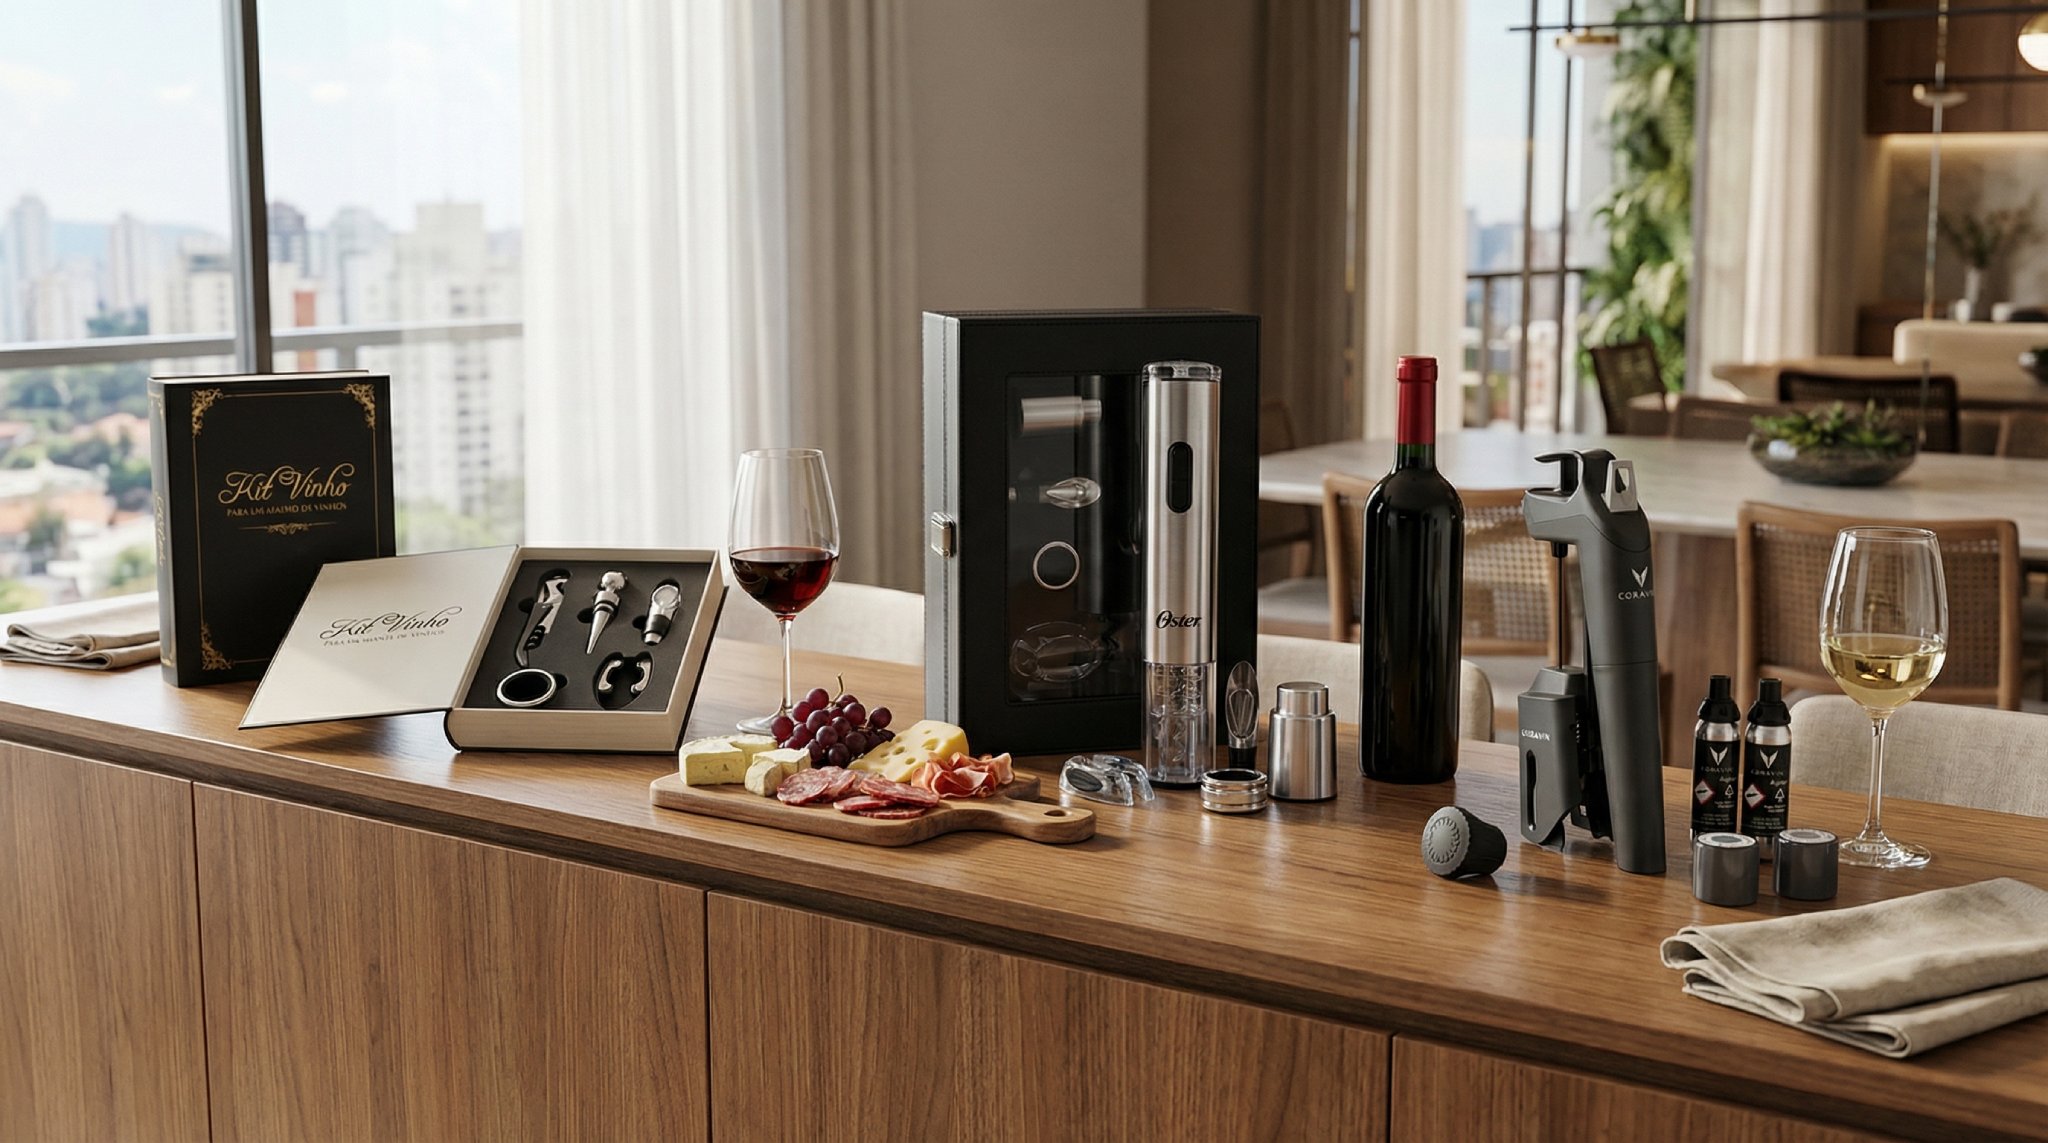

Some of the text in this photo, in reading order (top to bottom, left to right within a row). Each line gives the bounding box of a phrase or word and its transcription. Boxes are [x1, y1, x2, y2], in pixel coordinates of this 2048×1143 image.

[218, 463, 355, 504] Kit Vinho
[319, 606, 462, 639] Kit Vinho
[1156, 610, 1202, 629] Oster
